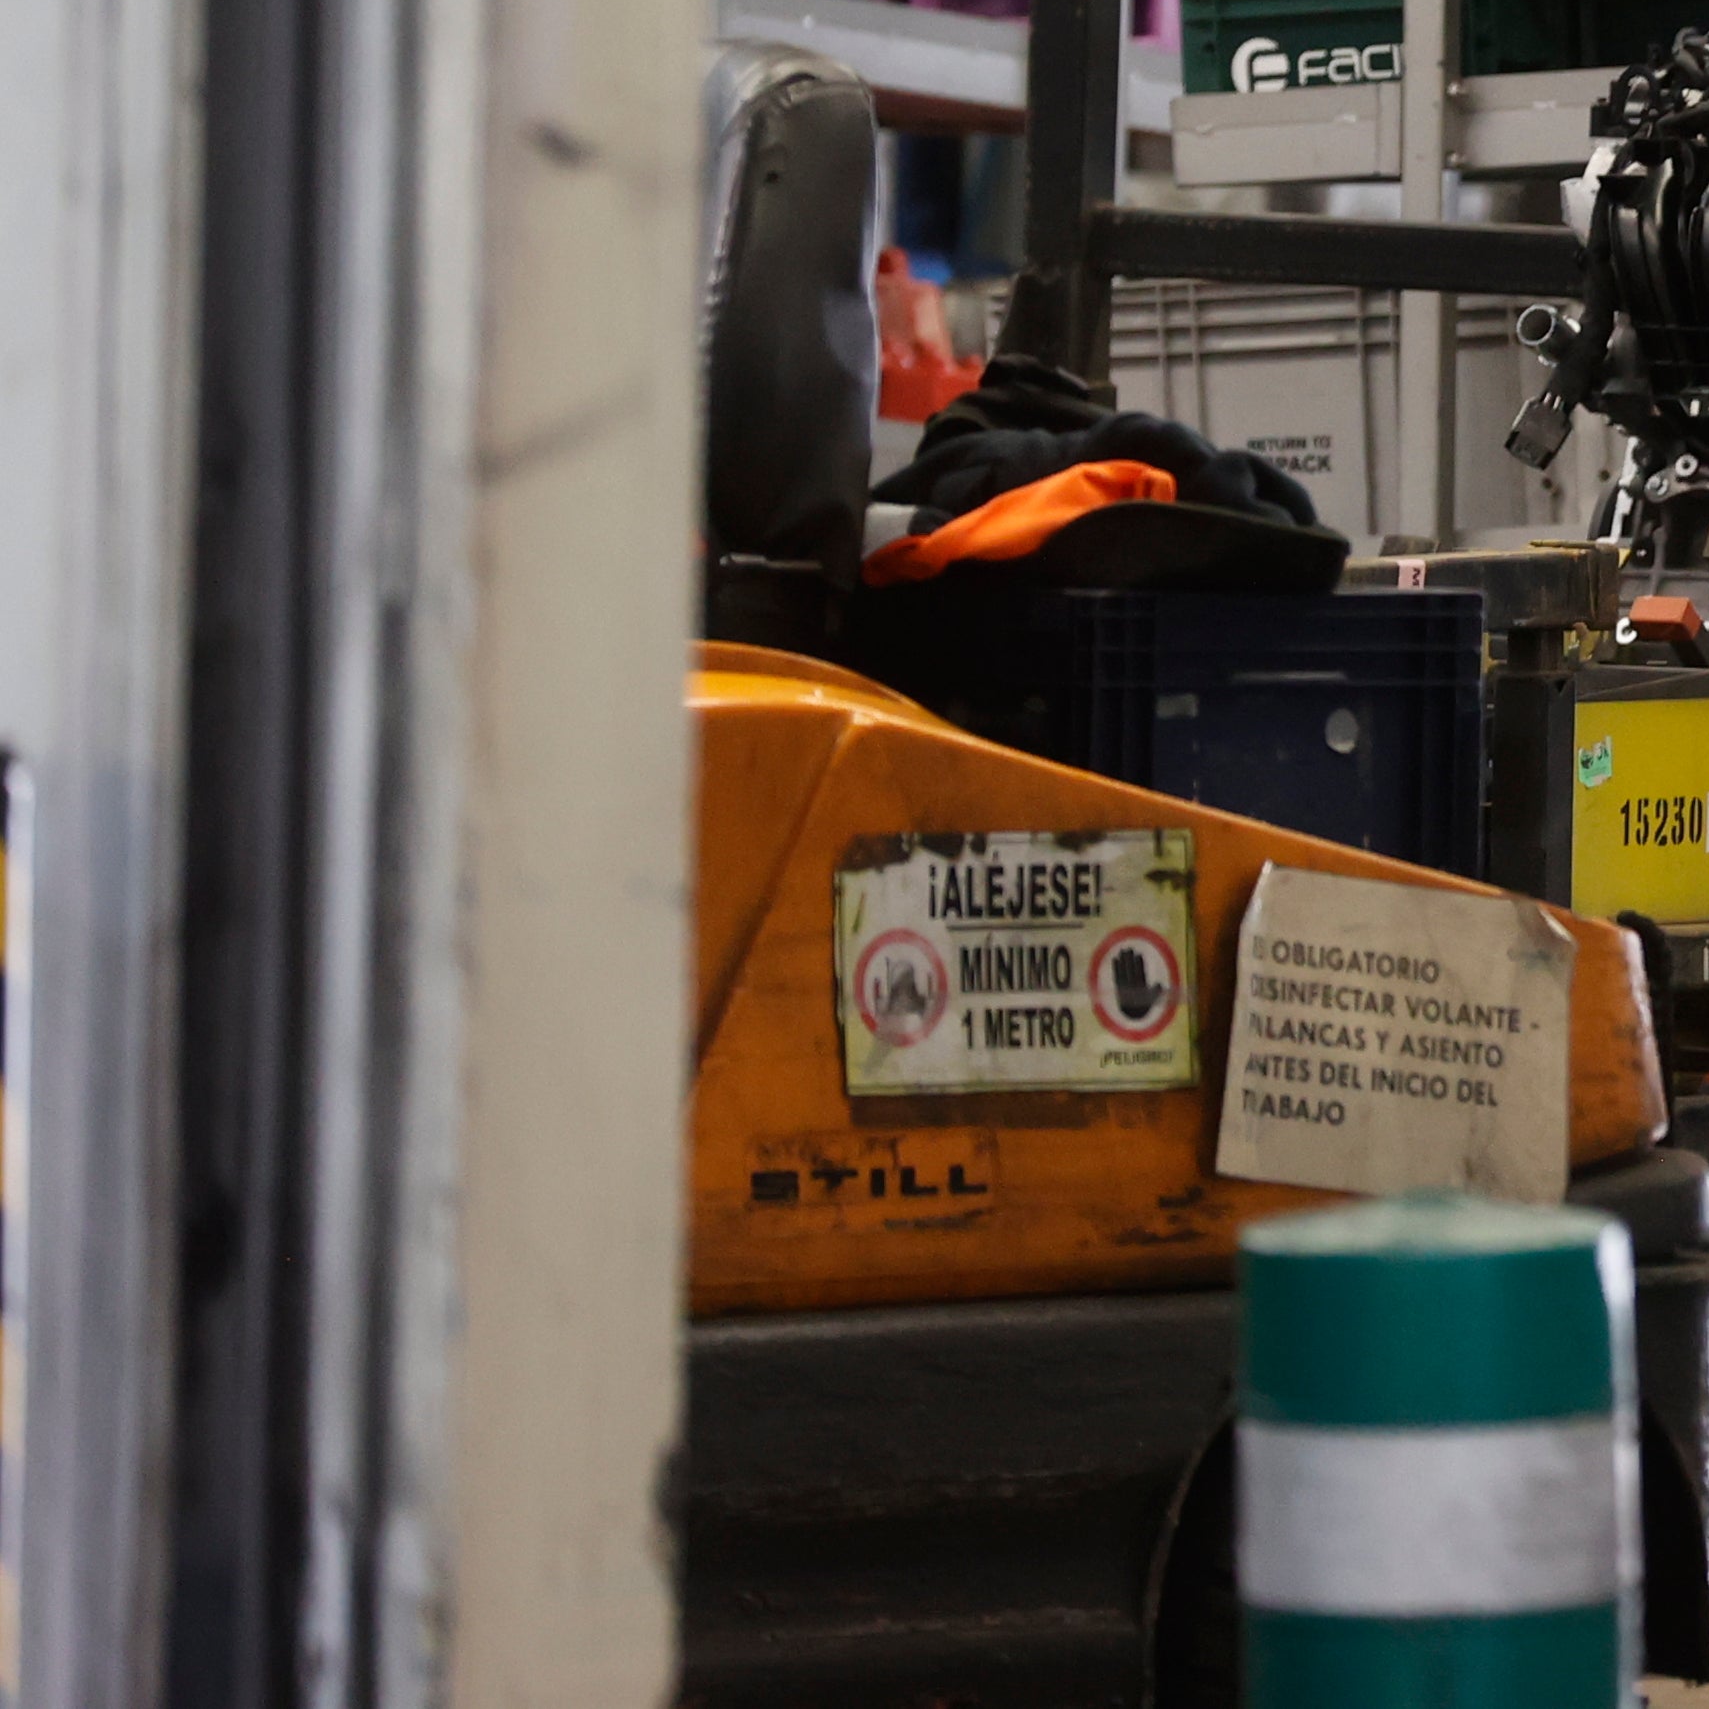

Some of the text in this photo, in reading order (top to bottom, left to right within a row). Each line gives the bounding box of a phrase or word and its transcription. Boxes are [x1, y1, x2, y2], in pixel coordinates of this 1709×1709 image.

[1247, 435, 1332, 450] RETURN TO
[1620, 796, 1703, 846] 15230
[928, 850, 1102, 919] ¡ALÉJESE!
[961, 933, 1072, 993] MÍNIMO
[1272, 940, 1440, 984] OBLIGATORIO
[962, 1007, 1074, 1049] 1 METRO
[1405, 995, 1522, 1034] VOLANTE
[1376, 1032, 1389, 1053] Y
[1400, 1034, 1504, 1069] ASIENTO
[1244, 1053, 1498, 1107] ANTES DEL INICIO DEL
[1241, 1088, 1346, 1126] TRABAJO
